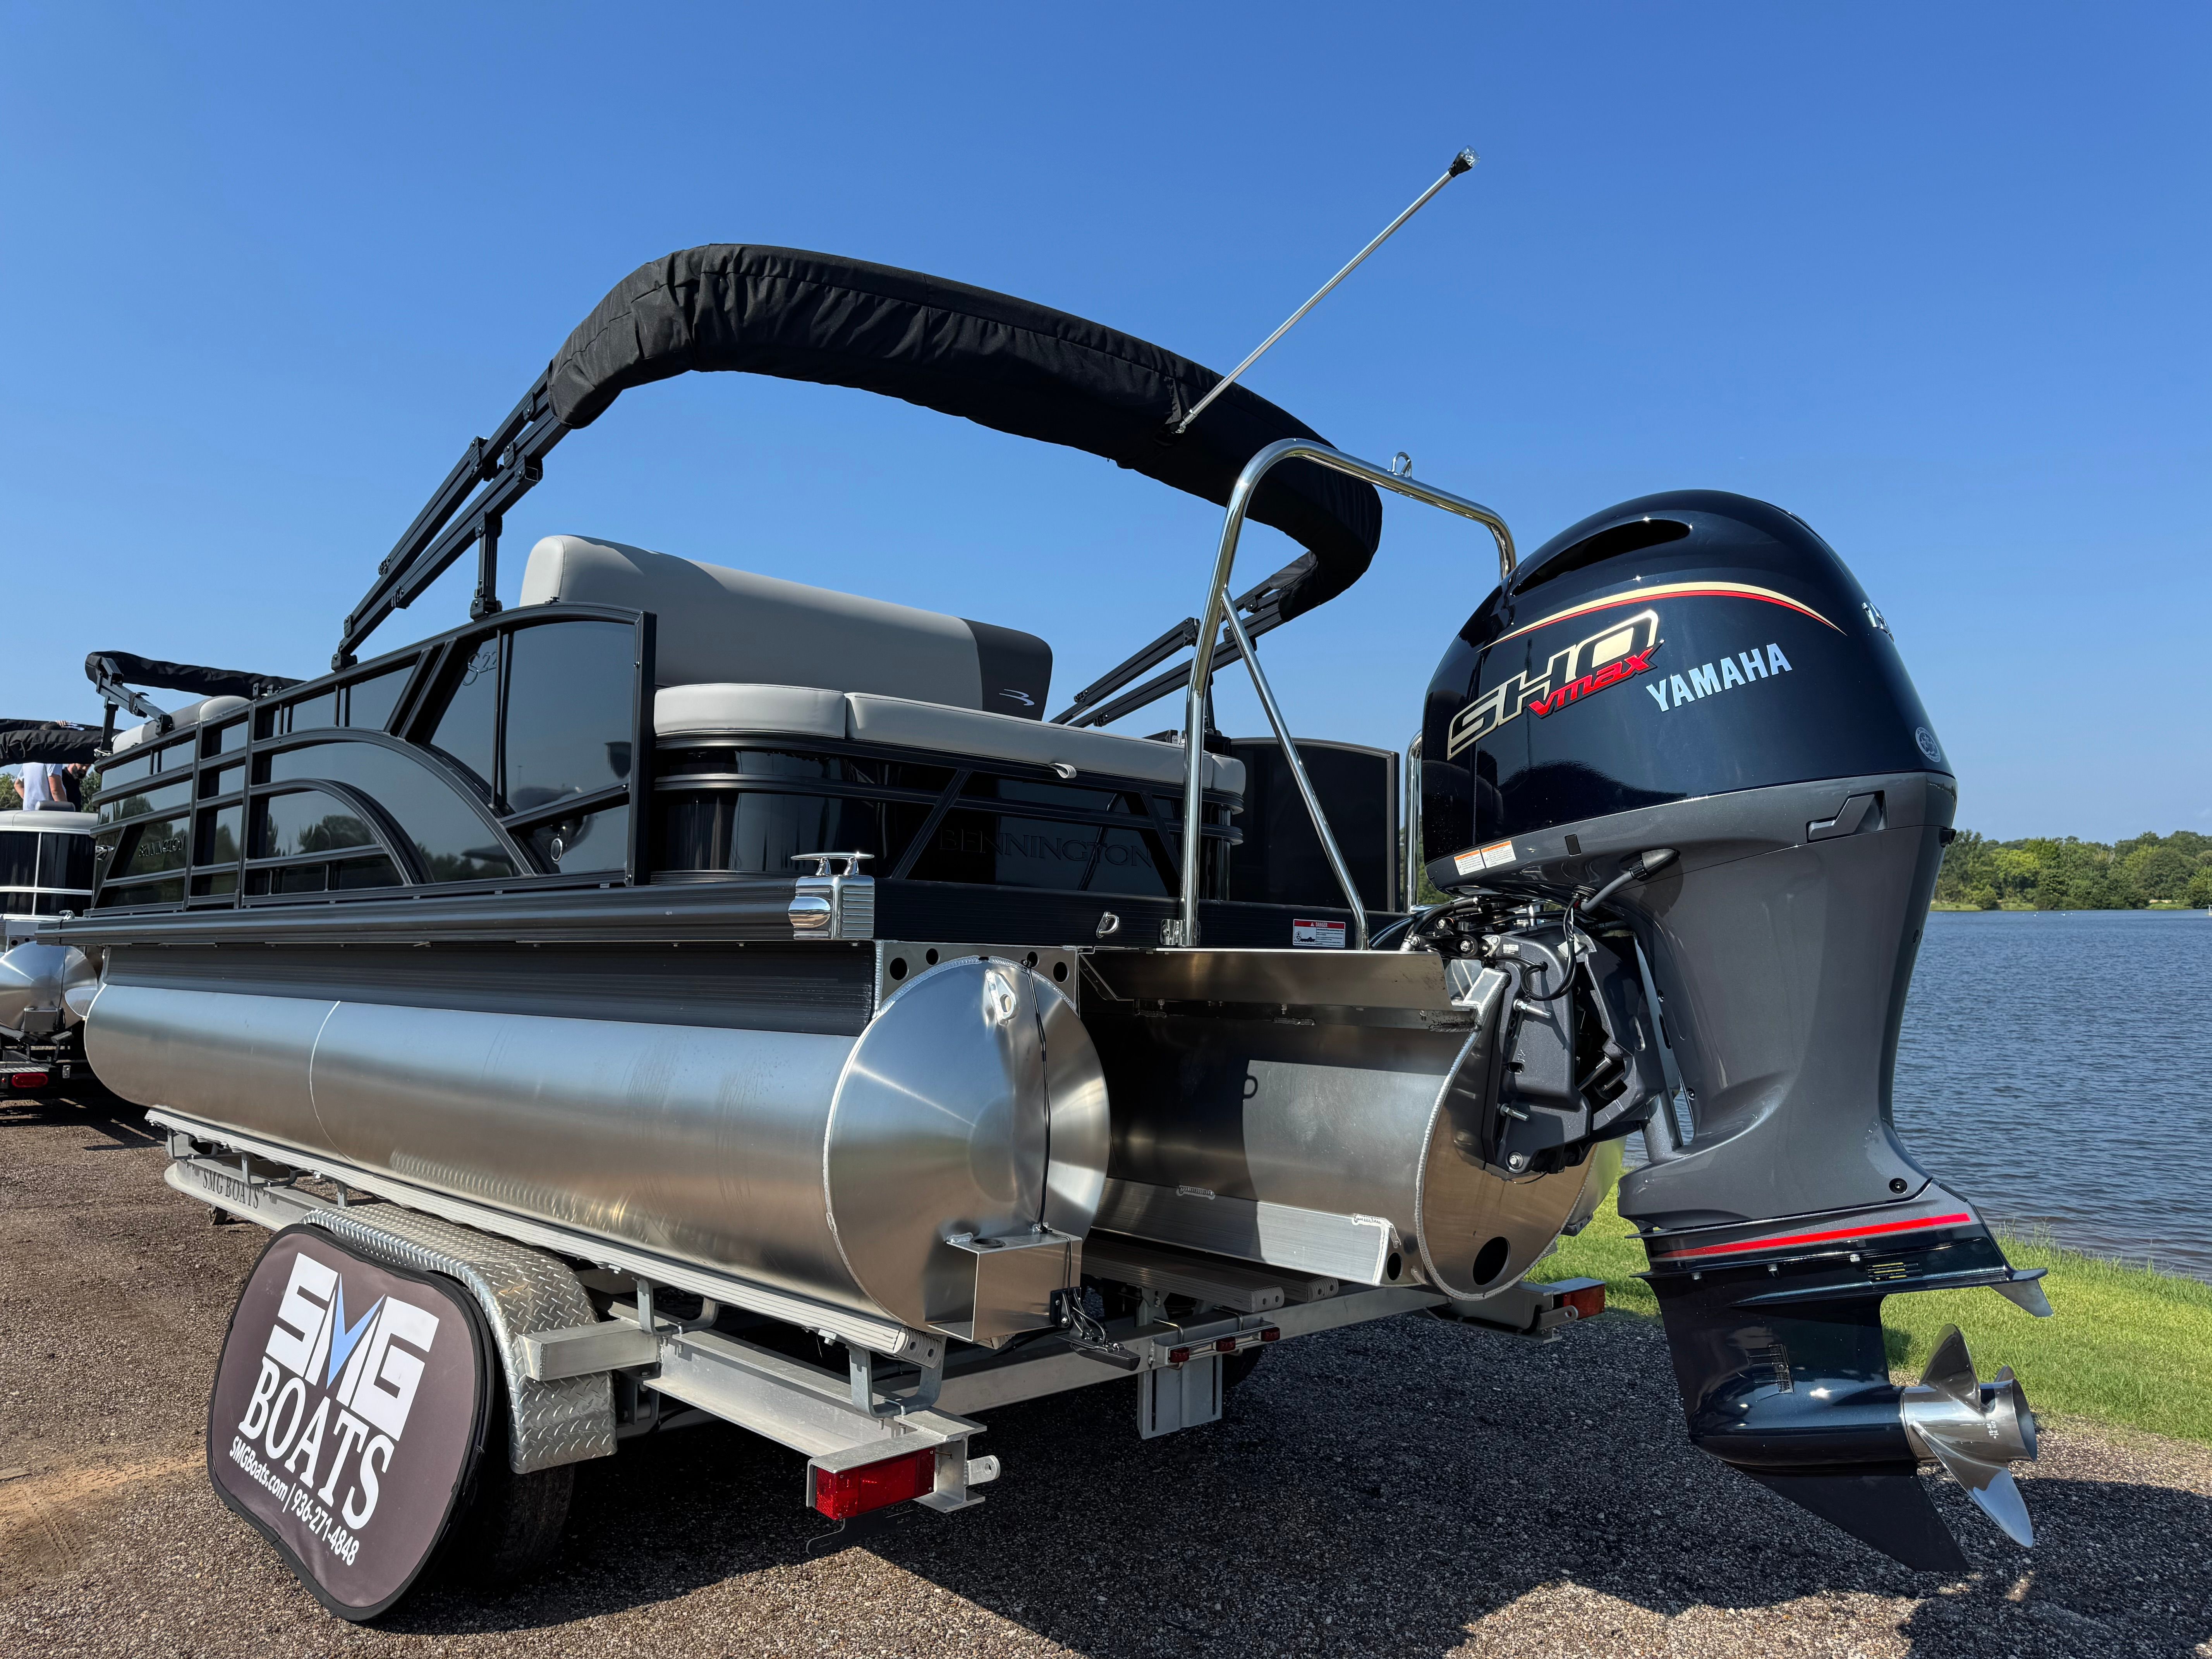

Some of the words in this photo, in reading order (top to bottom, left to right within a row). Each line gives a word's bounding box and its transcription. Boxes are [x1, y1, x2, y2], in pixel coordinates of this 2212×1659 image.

[1448, 609, 1659, 760] SHO
[1646, 643, 1792, 712] YAMAHA
[939, 828, 1152, 868] BENNINGTON
[203, 1169, 223, 1194] SMG
[225, 1176, 259, 1209] BOATS
[265, 1252, 440, 1441] SMG
[230, 1436, 287, 1501] SMGBoats.com
[291, 1489, 359, 1566] 936-271-4848
[239, 1357, 395, 1529] BOATS
